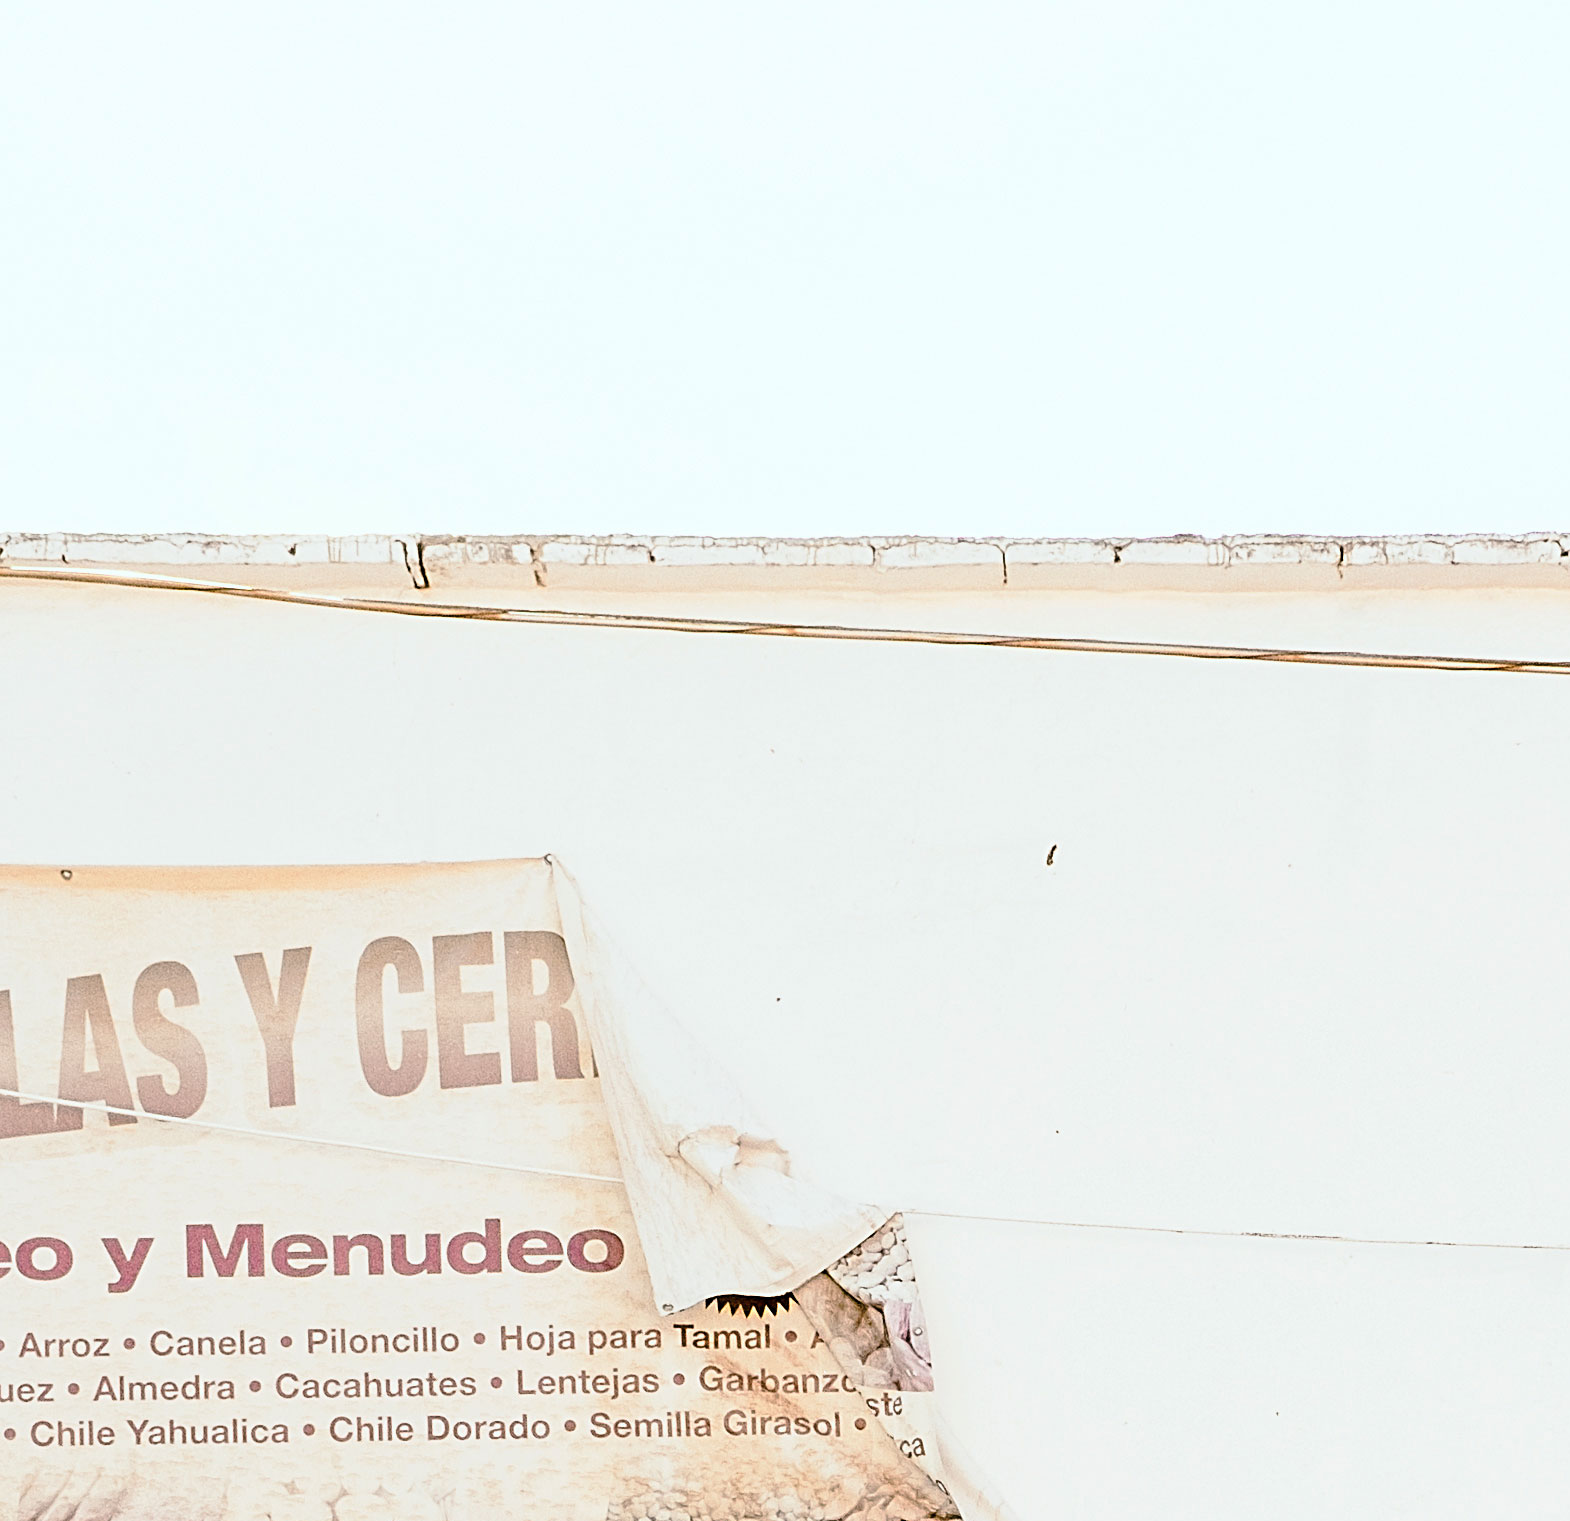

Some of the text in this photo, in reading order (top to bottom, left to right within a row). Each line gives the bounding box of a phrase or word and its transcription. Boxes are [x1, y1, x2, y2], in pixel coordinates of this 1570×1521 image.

[234, 946, 312, 1108] Y
[355, 931, 598, 1097] CER
[101, 1238, 154, 1293] y
[186, 1218, 624, 1278] Menudeo
[19, 1322, 771, 1357] Arroz Canela Piloncillo Hoja para Tamal
[93, 1375, 235, 1401] Almedra
[276, 1372, 476, 1399] Cacahuates
[518, 1368, 659, 1400] Lentejas
[31, 1410, 841, 1446] Chile Yahualica Chile Dorado Semilla Girasol
